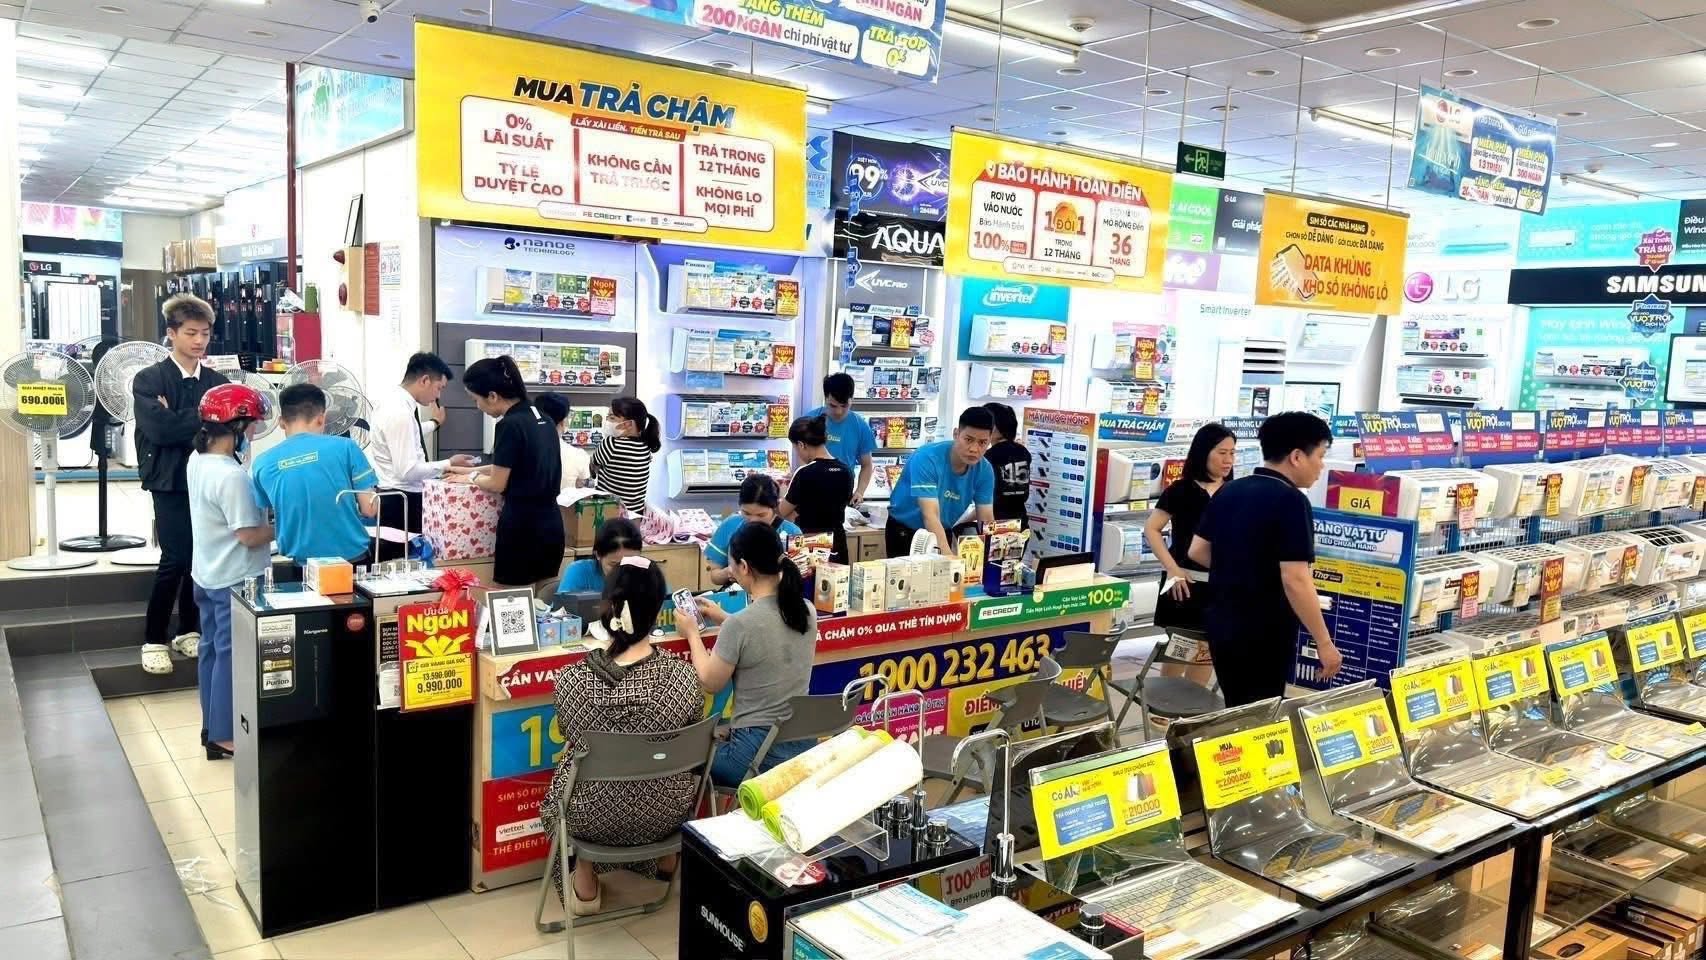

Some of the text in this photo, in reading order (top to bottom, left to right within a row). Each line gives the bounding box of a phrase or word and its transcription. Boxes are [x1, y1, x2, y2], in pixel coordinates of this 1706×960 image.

[802, 31, 821, 50] phí
[821, 36, 837, 52] vật
[838, 40, 853, 54] tư
[512, 76, 736, 132] MUA TRẢ CHẬM
[505, 113, 532, 131] 0%
[575, 117, 681, 139] LẤY XÀI TIỀN TRẢ SAU
[483, 128, 554, 151] LÃI SUẤT
[693, 144, 766, 164] TRẢ TRONG
[588, 152, 672, 176] KHÔNG CẦN
[698, 160, 760, 178] 12 THÁNG
[474, 175, 564, 197] DUYỆT CAO
[998, 161, 1142, 202] BẢO HÀNH TOÀN DIỆN
[695, 185, 762, 204] KHÔNG LO
[990, 190, 1006, 201] RƠI
[705, 202, 754, 218] MỌI PHÍ
[983, 201, 1023, 217] VÀO NƯỚC
[523, 238, 576, 250] nanoe
[872, 224, 945, 255] AQUA
[973, 230, 1009, 251] 100%
[1110, 233, 1132, 256] 36
[523, 247, 576, 257] TECHNOLOGY
[1044, 247, 1081, 261] 12 THÁNG
[41, 263, 53, 271] LG
[1304, 254, 1372, 277] DATA KHỦNG
[1303, 277, 1388, 300] KHO SỐ KHỔNG LỒ
[1099, 419, 1117, 428] MUA
[1117, 418, 1135, 429] TRẢ
[1135, 419, 1164, 433] CHẬM
[1350, 496, 1371, 510] GIÁ
[1344, 525, 1365, 541] VẬT
[1367, 529, 1388, 543] TƯ
[1088, 587, 1114, 606] 100
[982, 605, 1019, 617] FE CREDIT
[407, 609, 469, 636] NgoN
[824, 625, 856, 643] CHẬM
[857, 624, 874, 637] 0%
[874, 621, 897, 634] QUA
[898, 616, 918, 631] THẺ
[919, 615, 936, 630] TÍN
[937, 611, 963, 627] DỤNG
[860, 633, 1052, 700] 1900 232 463
[417, 677, 463, 694] 9.990.000
[502, 668, 532, 691] CẦN
[1223, 770, 1251, 788] 2.000.000
[497, 787, 518, 803] SIM
[517, 801, 530, 813] ĐỦ
[1129, 798, 1162, 817] 210.000
[498, 823, 525, 835] viettel
[492, 837, 539, 857] THẺ ĐIỆN
[700, 904, 746, 954] SUNHOUSE
